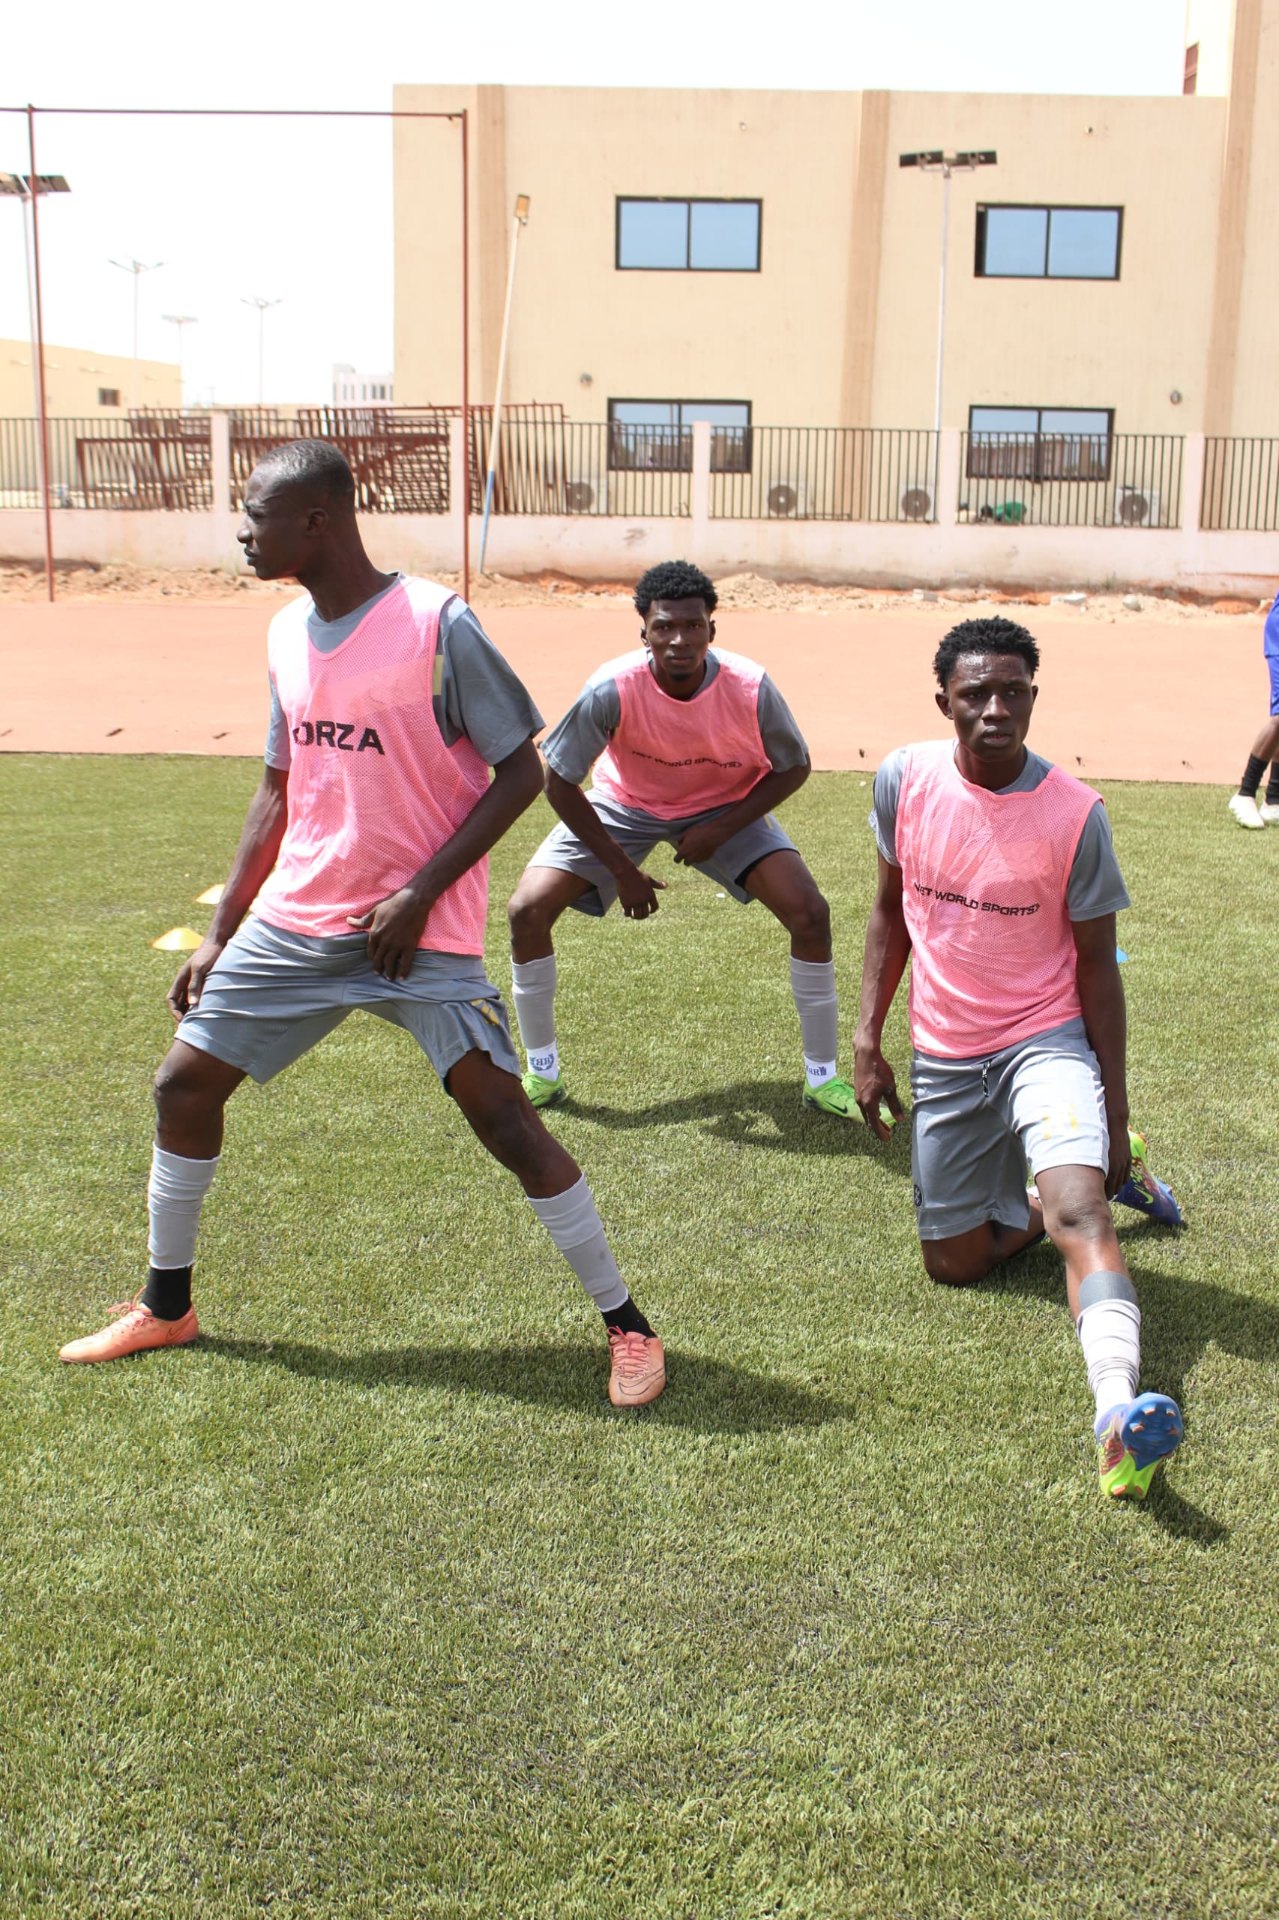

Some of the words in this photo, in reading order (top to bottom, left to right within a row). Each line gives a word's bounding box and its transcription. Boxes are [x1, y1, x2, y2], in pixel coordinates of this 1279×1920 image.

[292, 720, 385, 755] ORZA
[934, 889, 980, 910] WORLD
[981, 902, 1036, 917] SPORTS
